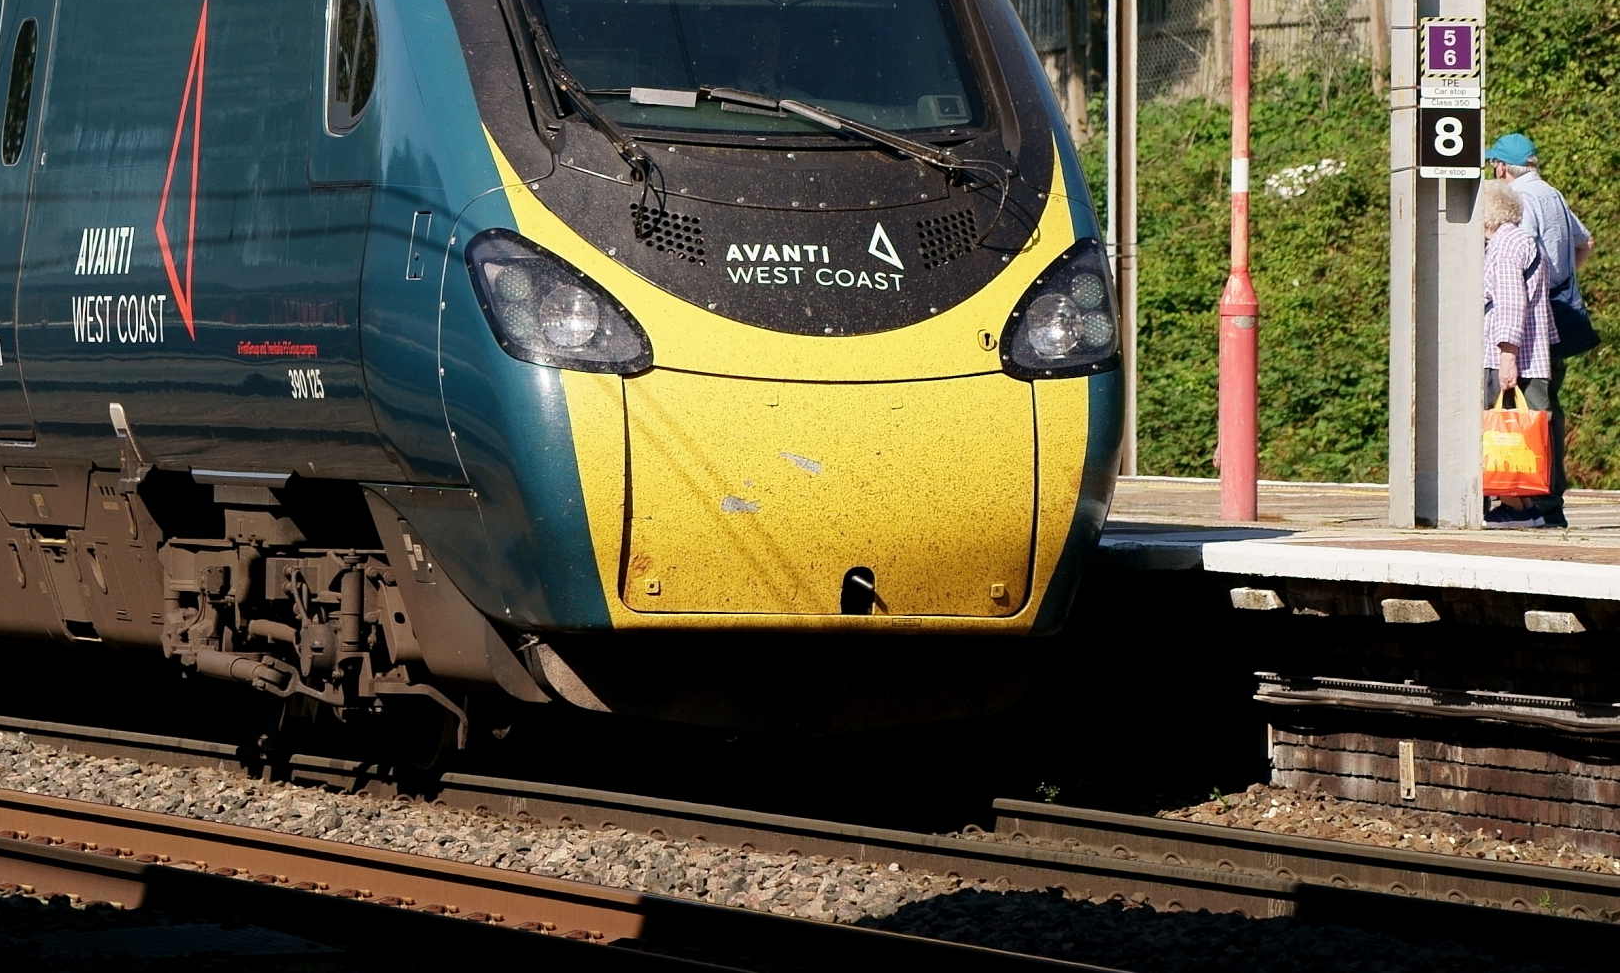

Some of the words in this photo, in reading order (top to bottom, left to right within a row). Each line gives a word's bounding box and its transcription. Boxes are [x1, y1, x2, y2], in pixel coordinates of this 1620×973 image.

[1443, 29, 1457, 47] 5
[1443, 49, 1457, 66] 6
[1433, 87, 1447, 96] Car
[1449, 88, 1467, 96] stop
[1441, 78, 1460, 88] TPE
[1431, 98, 1452, 106] Class
[1454, 99, 1470, 107] 350
[1434, 116, 1464, 157] 8
[1433, 167, 1446, 175] Car
[1449, 168, 1466, 176] stop
[74, 226, 135, 275] AVANTI
[726, 243, 830, 264] AVANTI
[726, 266, 804, 285] WEST
[815, 267, 904, 292] COAST
[72, 295, 113, 343] WEST
[117, 294, 167, 344] COAST
[288, 369, 308, 399] 390
[306, 368, 325, 399] 125
